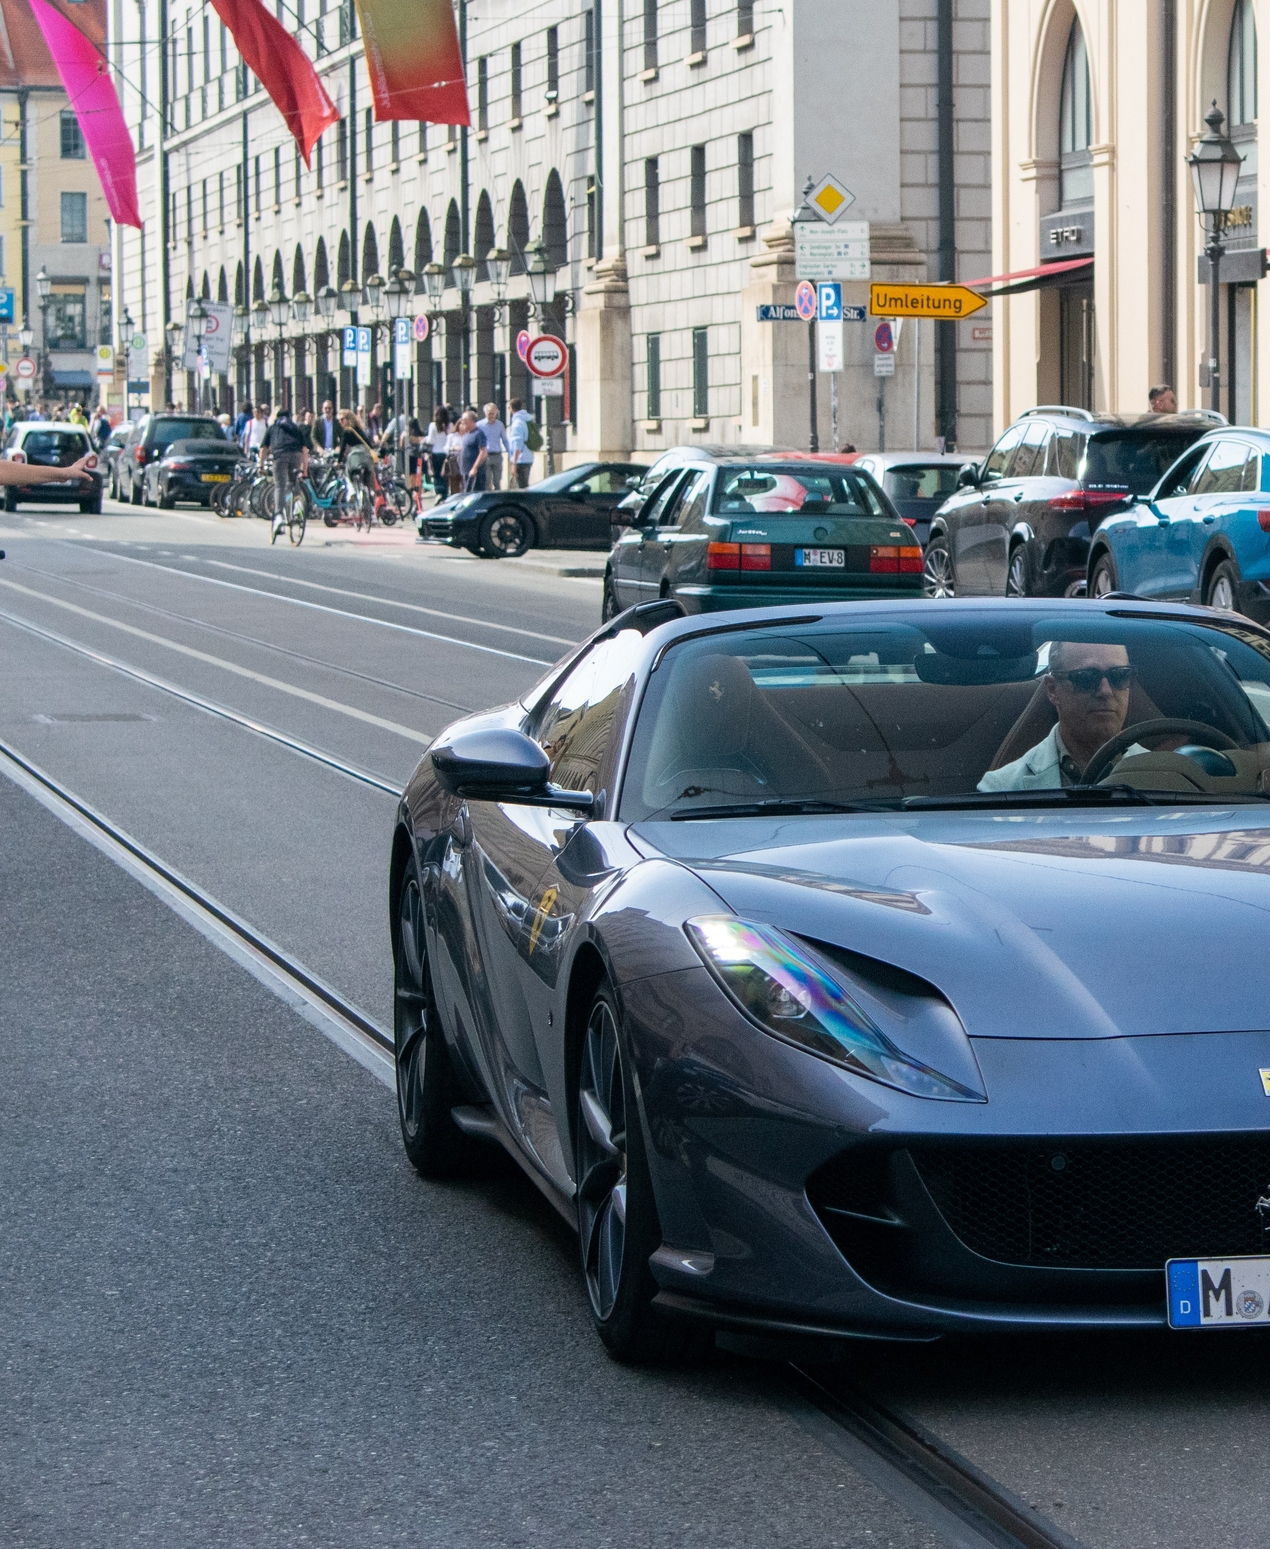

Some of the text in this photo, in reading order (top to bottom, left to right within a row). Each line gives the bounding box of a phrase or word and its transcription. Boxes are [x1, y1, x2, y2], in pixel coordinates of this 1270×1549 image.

[821, 287, 836, 317] P
[876, 292, 963, 314] Umleitung
[803, 550, 811, 564] M
[1201, 1267, 1233, 1318] M
[1180, 1301, 1191, 1314] D
